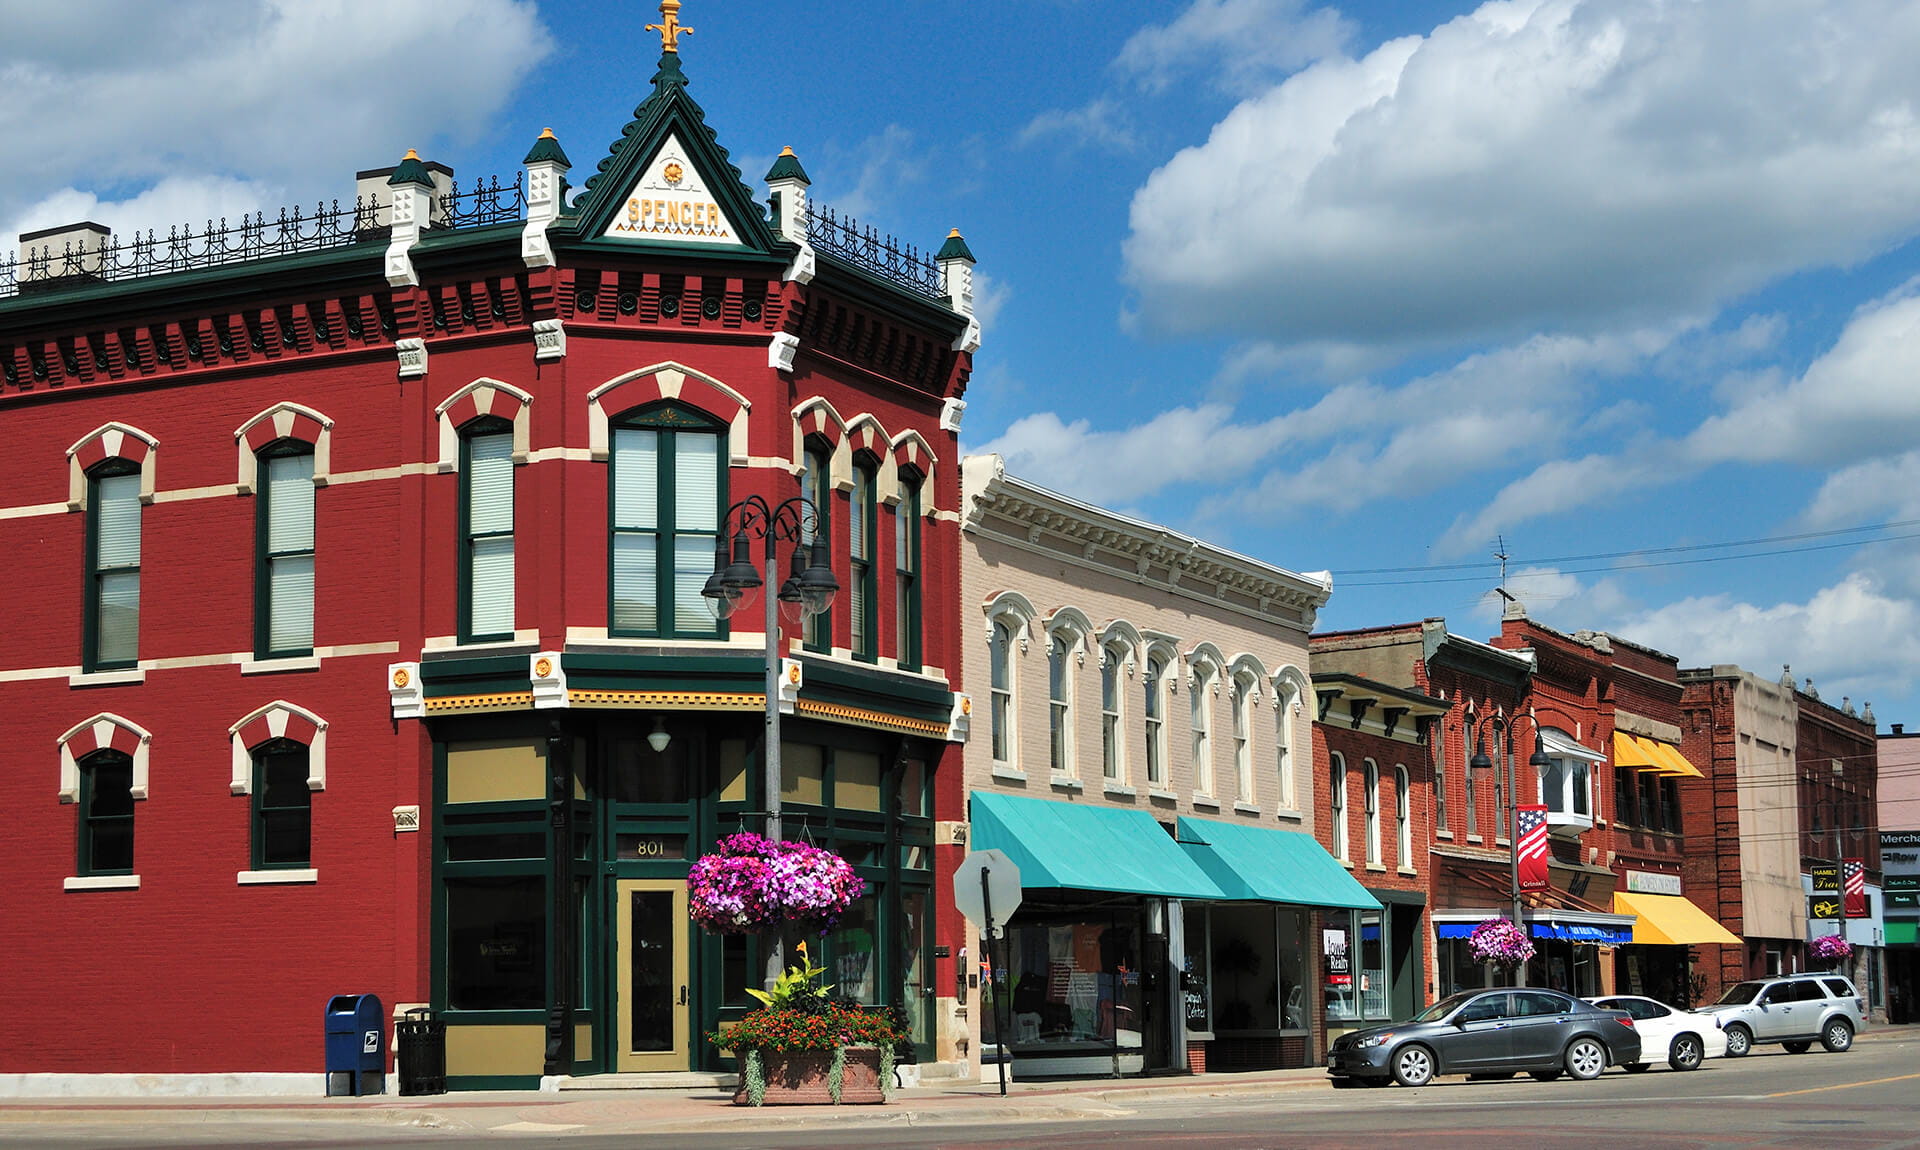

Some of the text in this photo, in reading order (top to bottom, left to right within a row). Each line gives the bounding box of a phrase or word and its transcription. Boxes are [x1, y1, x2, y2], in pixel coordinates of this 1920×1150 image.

[628, 198, 718, 228] SPENCER
[638, 841, 663, 855] 801
[1331, 955, 1348, 971] Realty
